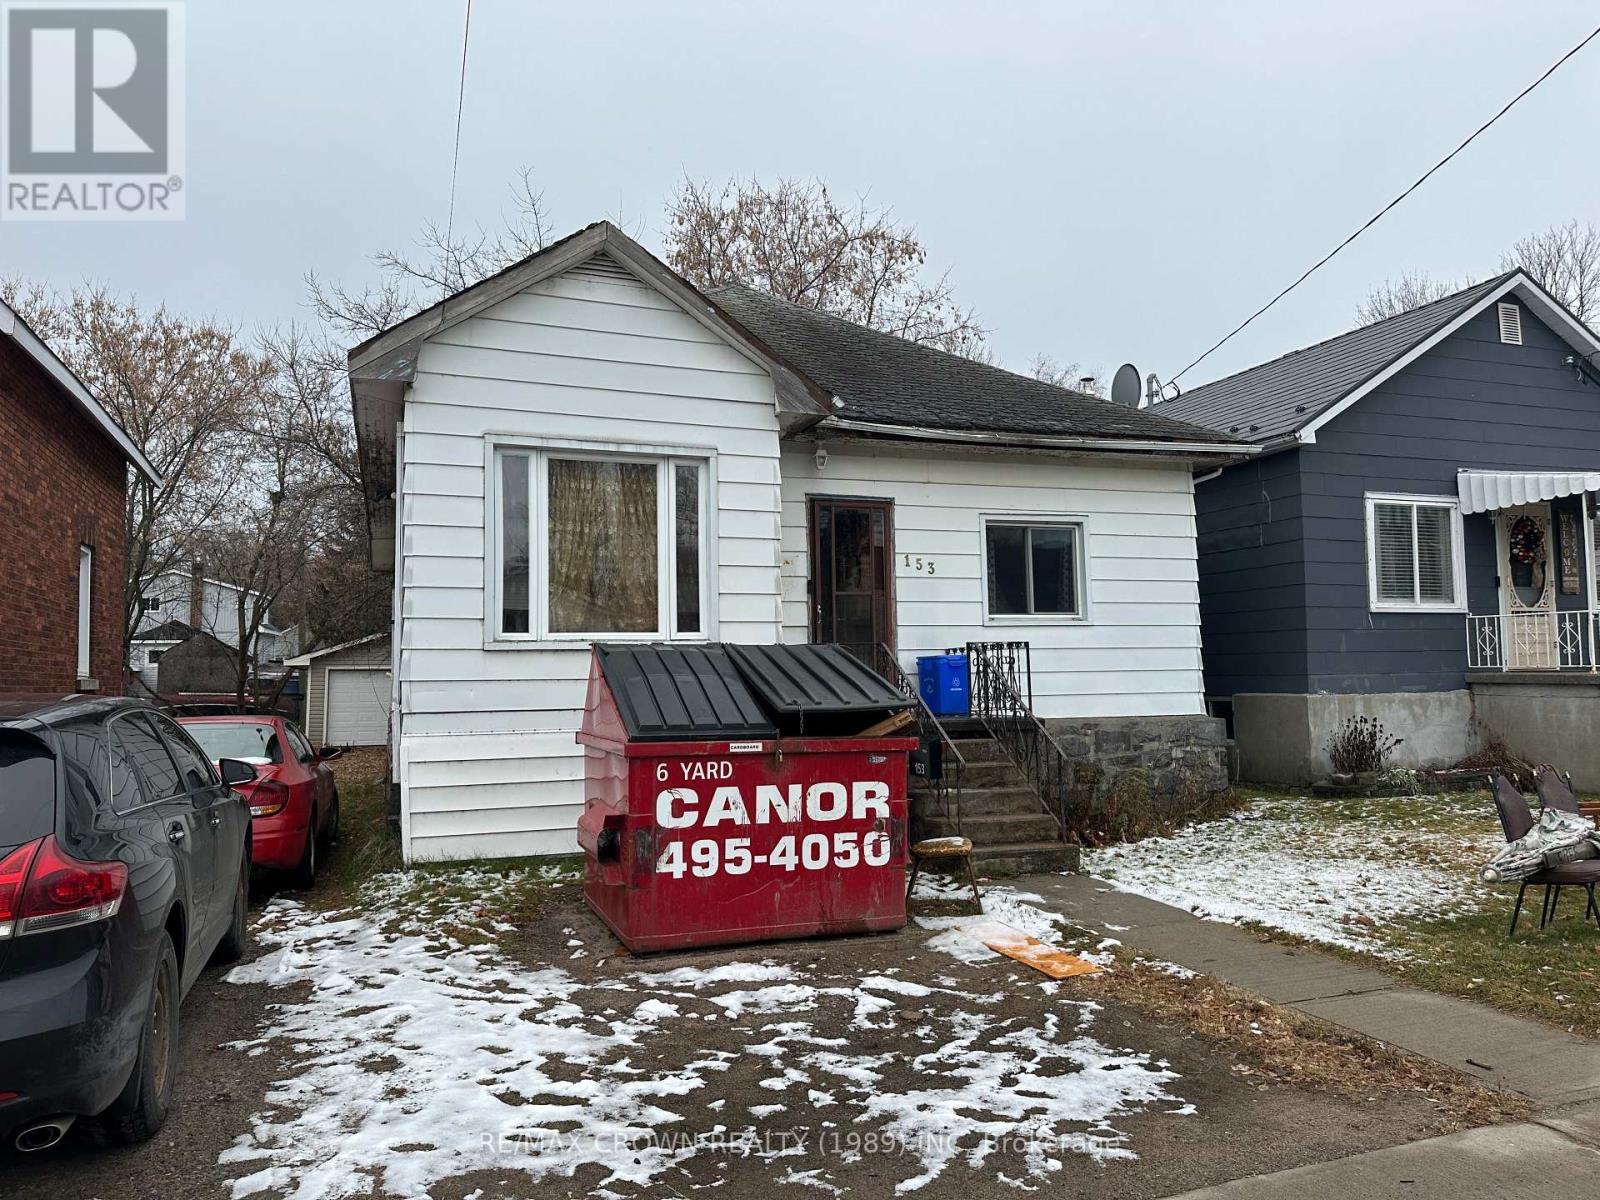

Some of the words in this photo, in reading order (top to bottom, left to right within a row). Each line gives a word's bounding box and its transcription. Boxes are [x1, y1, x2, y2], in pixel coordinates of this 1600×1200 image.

[1560, 514, 1572, 575] WELCOME
[904, 554, 935, 575] 153
[656, 763, 669, 782] 6
[680, 761, 733, 781] YARD
[914, 762, 925, 775] 153
[656, 781, 890, 829] CANOR
[655, 831, 891, 879] 495-4050
